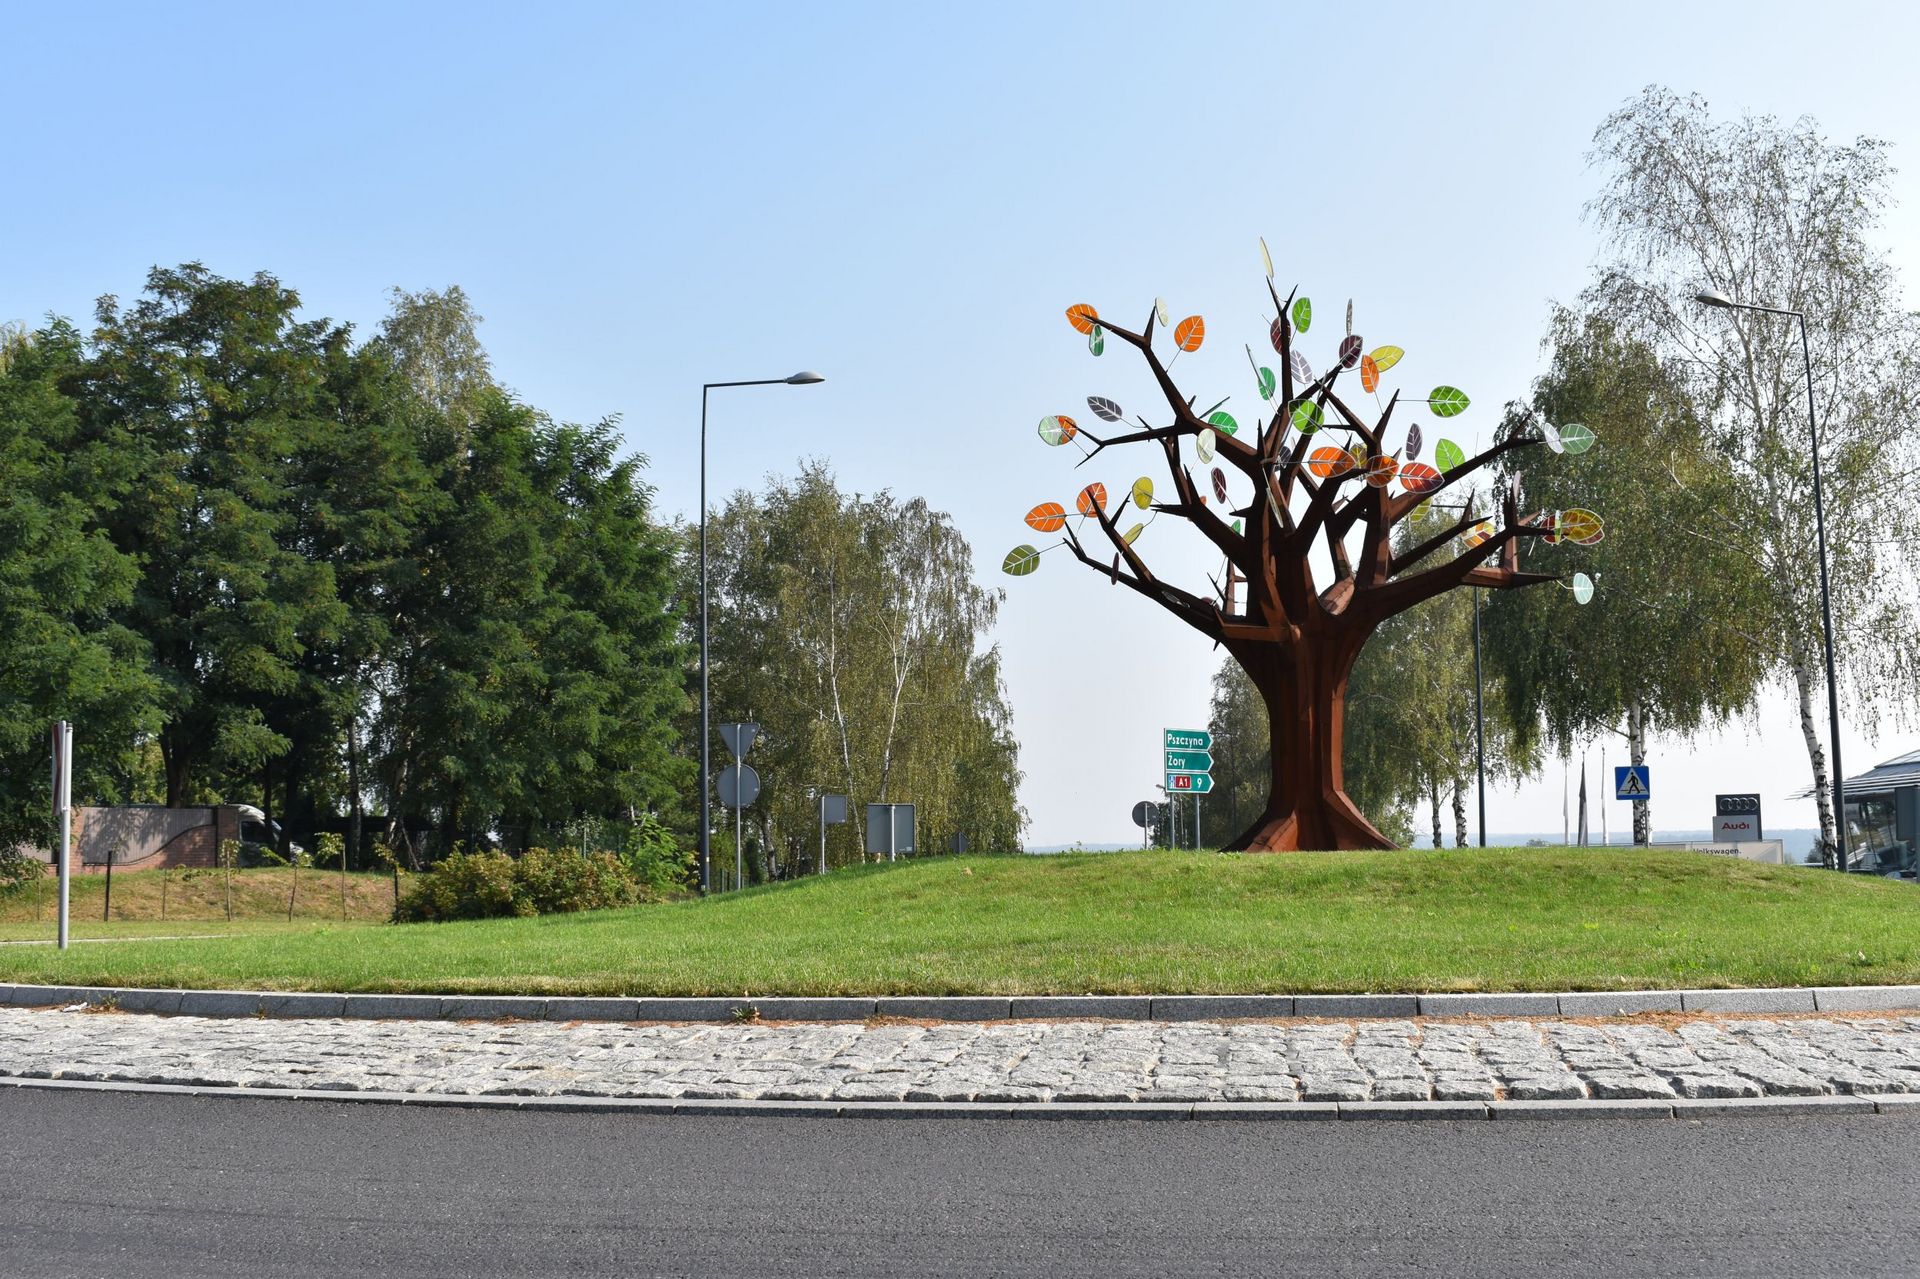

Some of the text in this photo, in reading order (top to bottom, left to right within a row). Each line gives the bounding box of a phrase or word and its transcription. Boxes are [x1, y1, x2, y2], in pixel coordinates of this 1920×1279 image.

[1167, 733, 1203, 748] Pszczyna
[1168, 752, 1185, 769] Żory
[1178, 777, 1203, 788] A1 9
[1721, 822, 1750, 830] Audi
